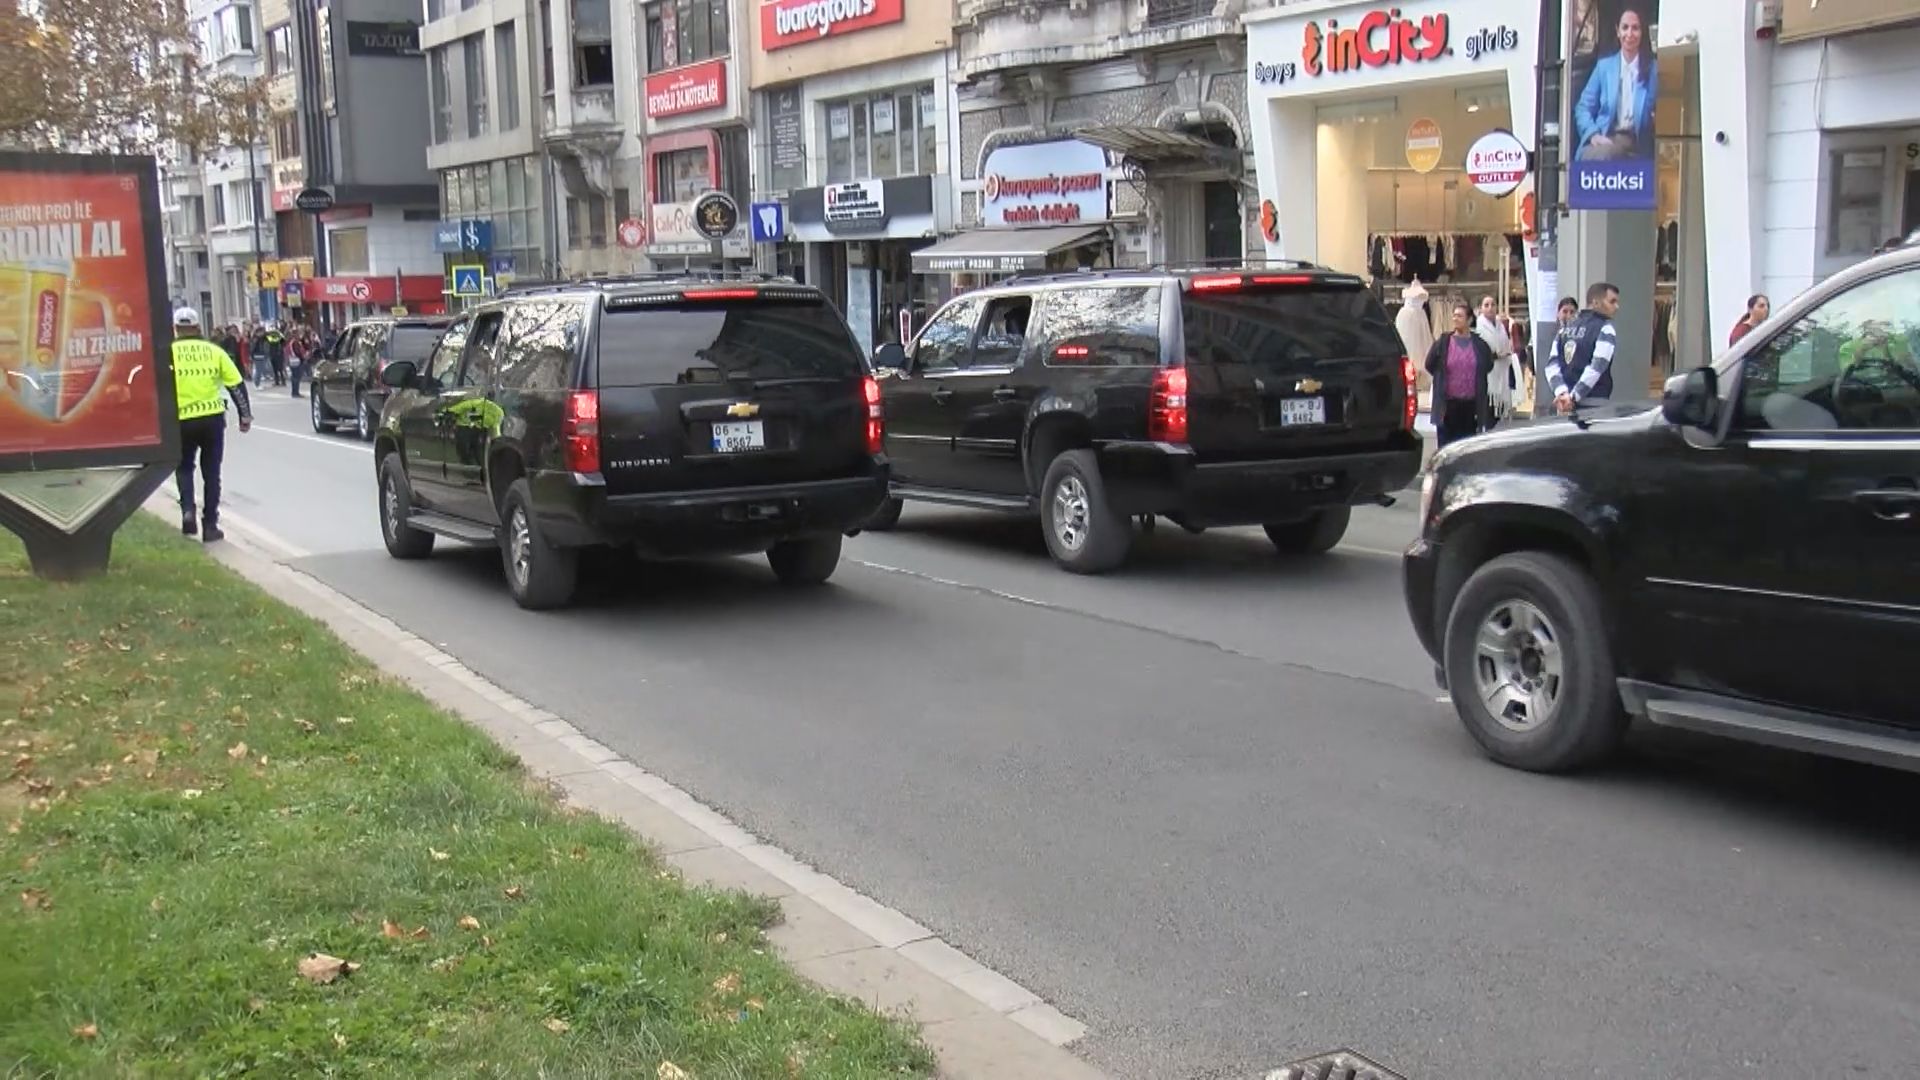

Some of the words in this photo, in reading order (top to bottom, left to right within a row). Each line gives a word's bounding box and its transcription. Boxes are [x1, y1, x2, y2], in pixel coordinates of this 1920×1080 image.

[1465, 25, 1518, 59] girls
[1254, 61, 1296, 84] boys
[1478, 172, 1515, 182] OUTLET
[1579, 170, 1644, 190] bitaksi
[45, 202, 71, 221] PRO
[1041, 203, 1080, 223] delight
[91, 220, 127, 258] AL
[67, 337, 88, 357] EN
[89, 329, 143, 355] ZENGİN
[714, 424, 730, 437] 06
[746, 423, 754, 434] L
[726, 435, 752, 448] 8567
